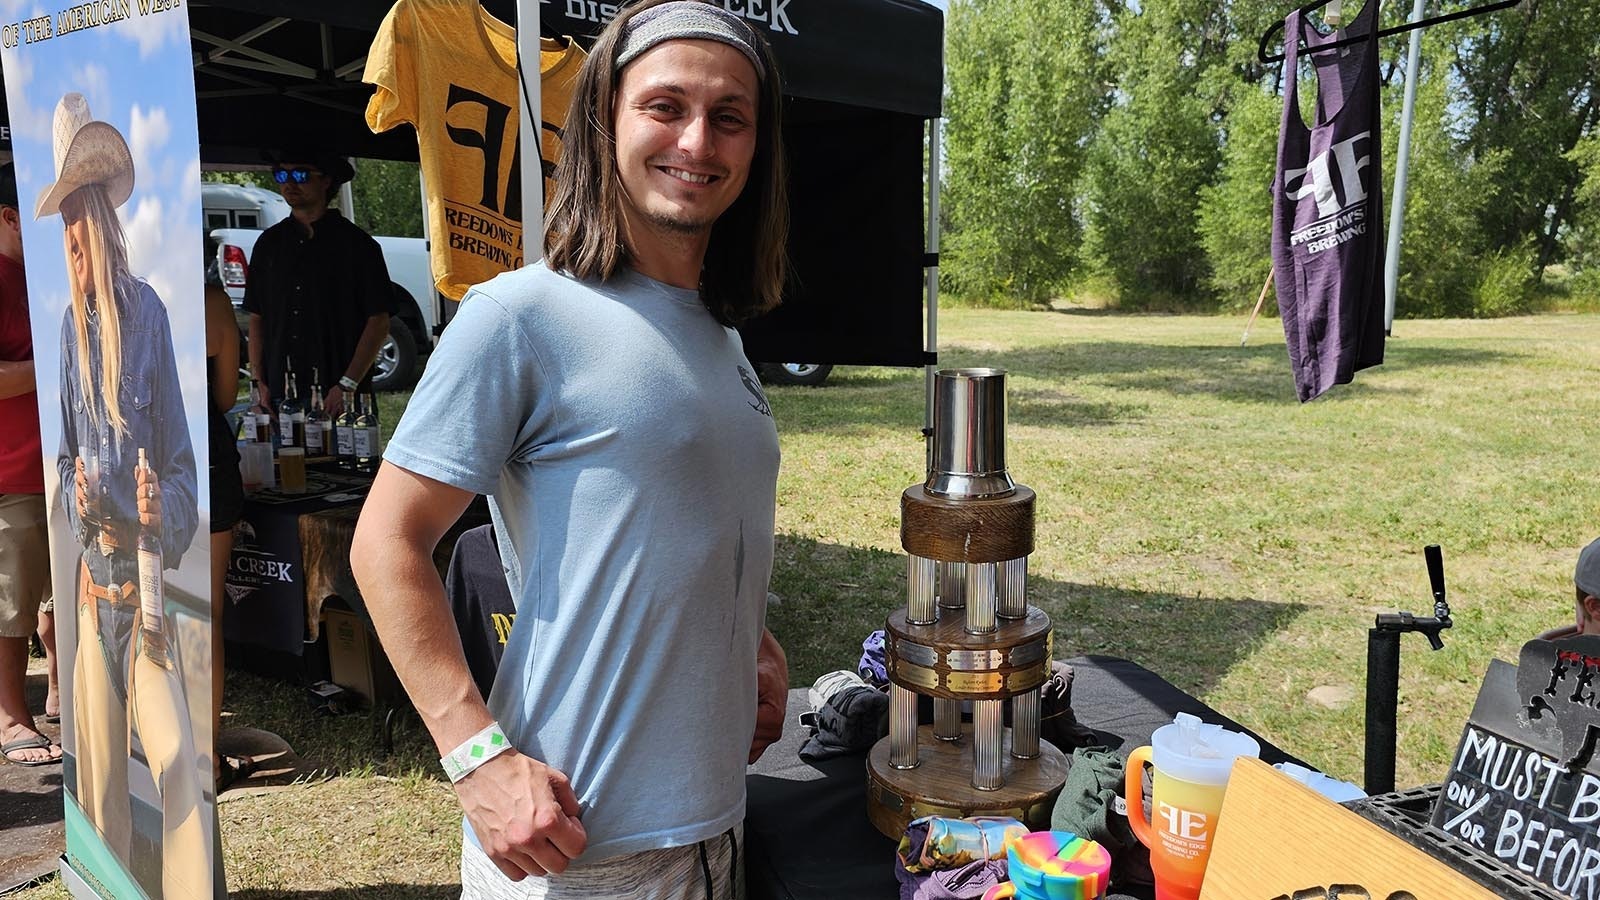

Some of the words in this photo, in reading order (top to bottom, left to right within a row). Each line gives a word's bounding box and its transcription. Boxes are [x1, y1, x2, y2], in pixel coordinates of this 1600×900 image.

[2, 24, 20, 48] OF
[22, 15, 52, 44] THE
[56, 0, 131, 36] AMERICAN
[725, 0, 799, 35] EEK
[448, 231, 512, 270] BREWING
[236, 556, 294, 583] CREEK
[1456, 727, 1571, 810] MUST
[1567, 774, 1600, 824] B
[1494, 808, 1600, 900] BEFOR
